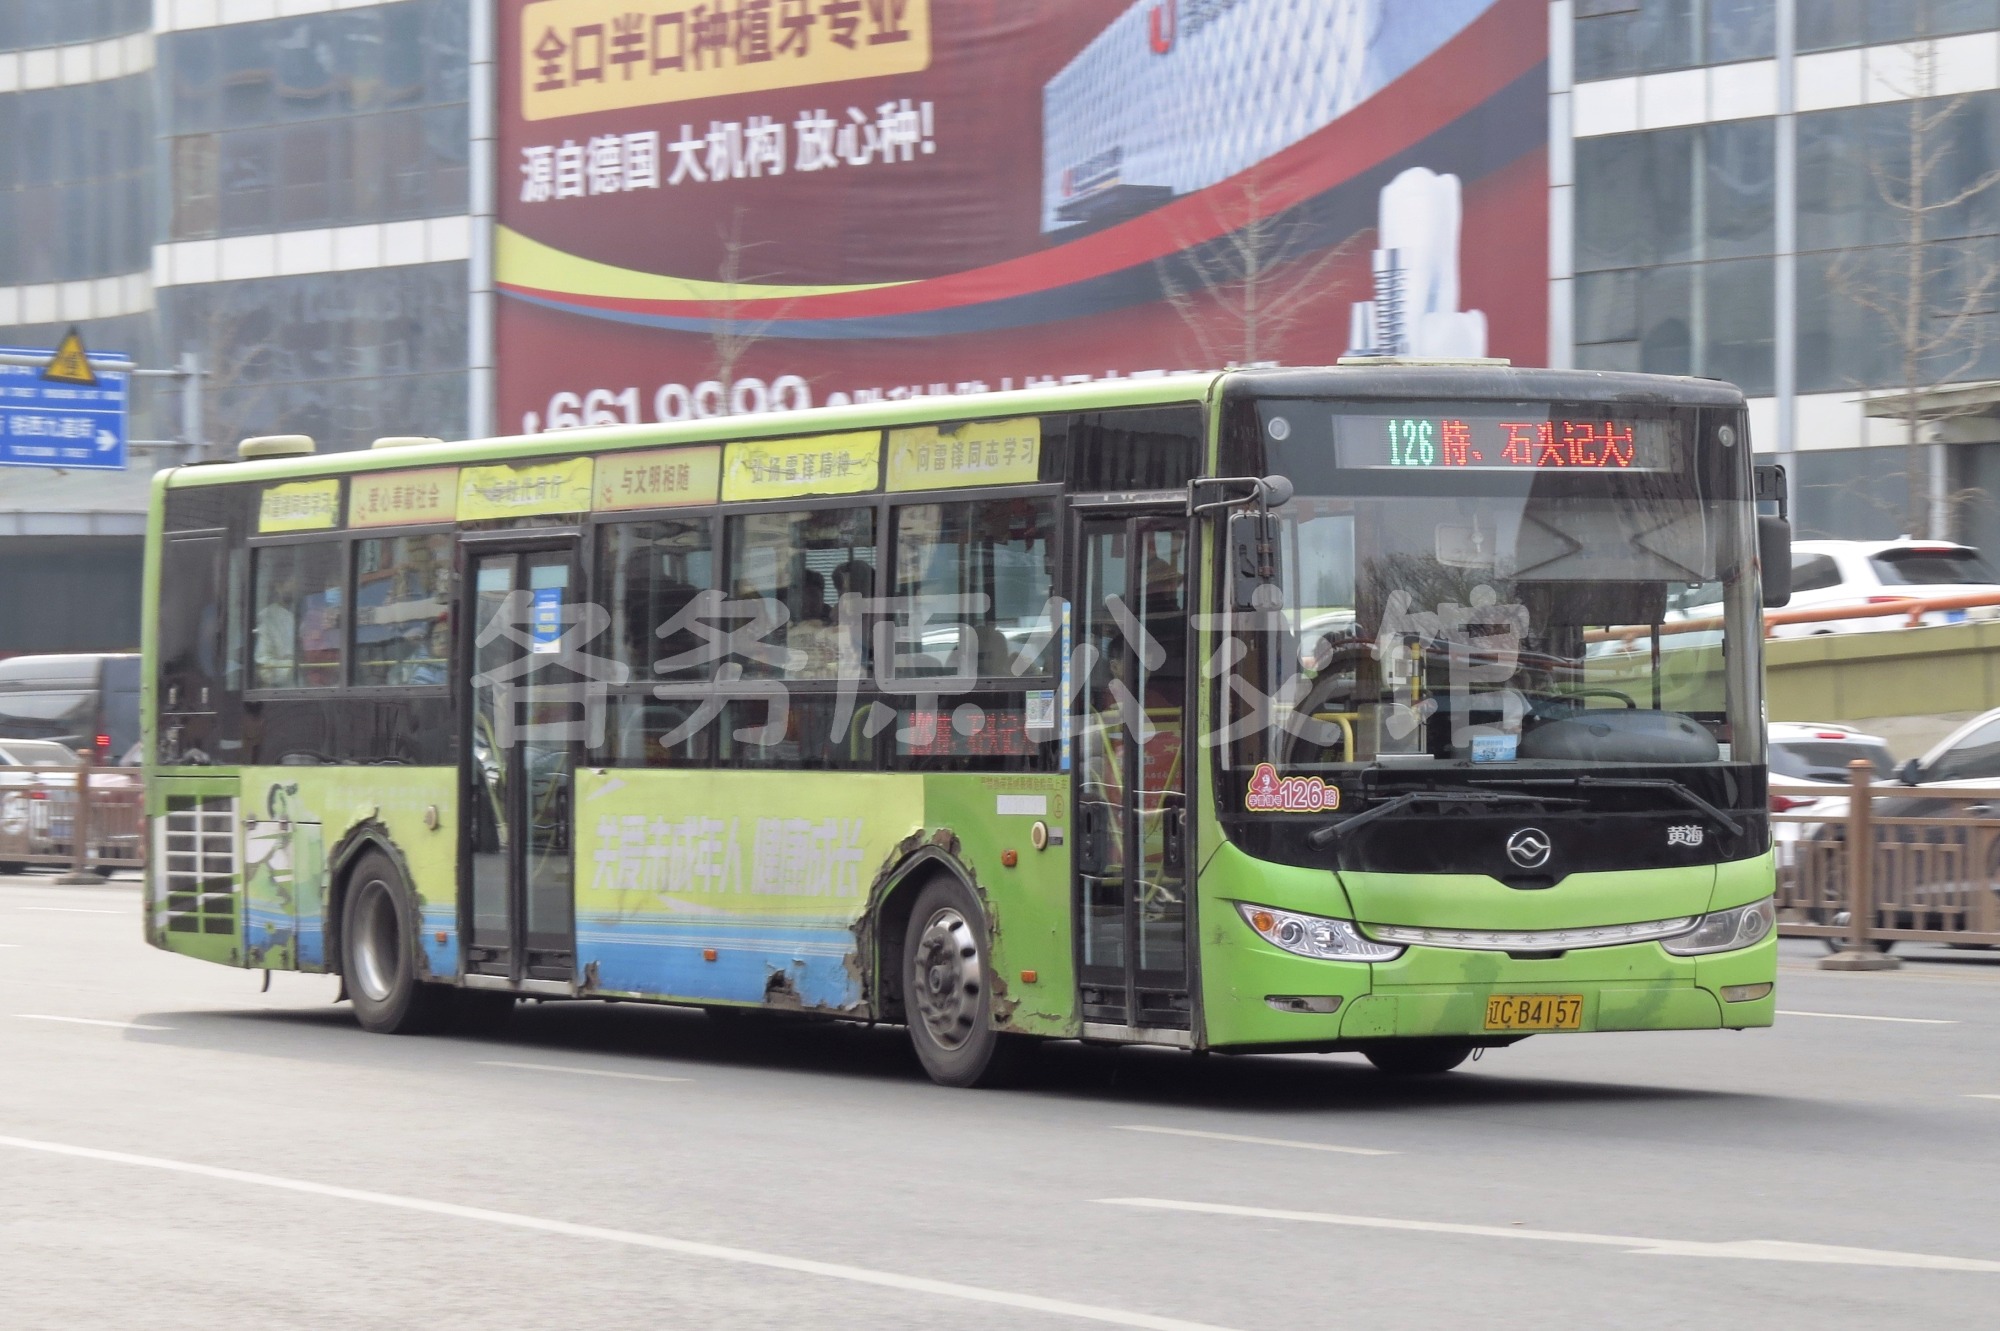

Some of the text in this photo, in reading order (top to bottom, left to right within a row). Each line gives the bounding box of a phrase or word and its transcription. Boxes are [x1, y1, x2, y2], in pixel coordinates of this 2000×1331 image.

[532, 0, 911, 93] 全口半口种植牙专业
[519, 130, 661, 203] 源自德国
[667, 115, 786, 185] 大机构
[917, 436, 1034, 472] 向雷锋同志学习
[1388, 419, 1434, 466] 126
[620, 462, 691, 495] 与文明相随
[751, 450, 851, 483] 弘扬雷锋精神
[591, 813, 864, 897] 关爱未成年人 健康成长
[1667, 824, 1704, 846] 黄海
